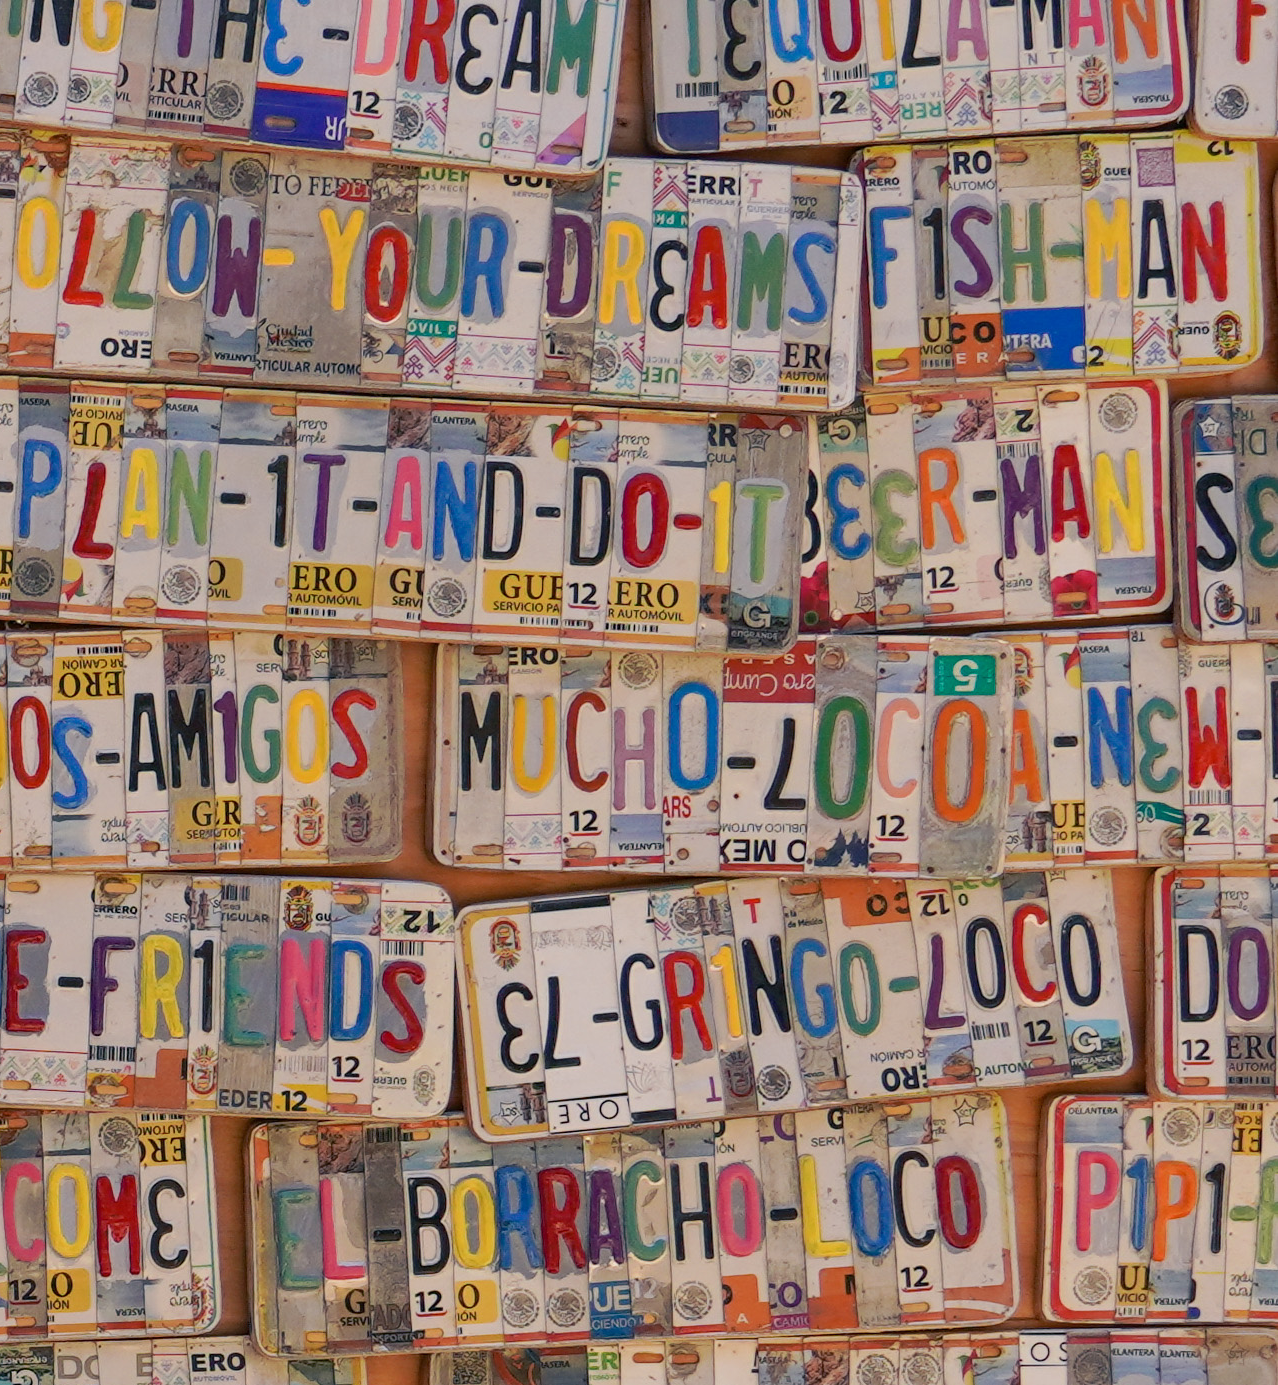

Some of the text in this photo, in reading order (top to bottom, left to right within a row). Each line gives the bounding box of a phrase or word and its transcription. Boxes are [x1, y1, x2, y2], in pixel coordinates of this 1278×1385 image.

[352, 90, 380, 115] 12
[926, 566, 956, 589] 12
[568, 582, 597, 605] 12
[569, 809, 598, 832] 12
[876, 815, 905, 837] 12
[1023, 1019, 1054, 1043] 12
[1181, 1039, 1211, 1061] 12
[281, 1090, 308, 1112] 12
[7, 1278, 38, 1301] 12
[413, 1290, 443, 1315] 12
